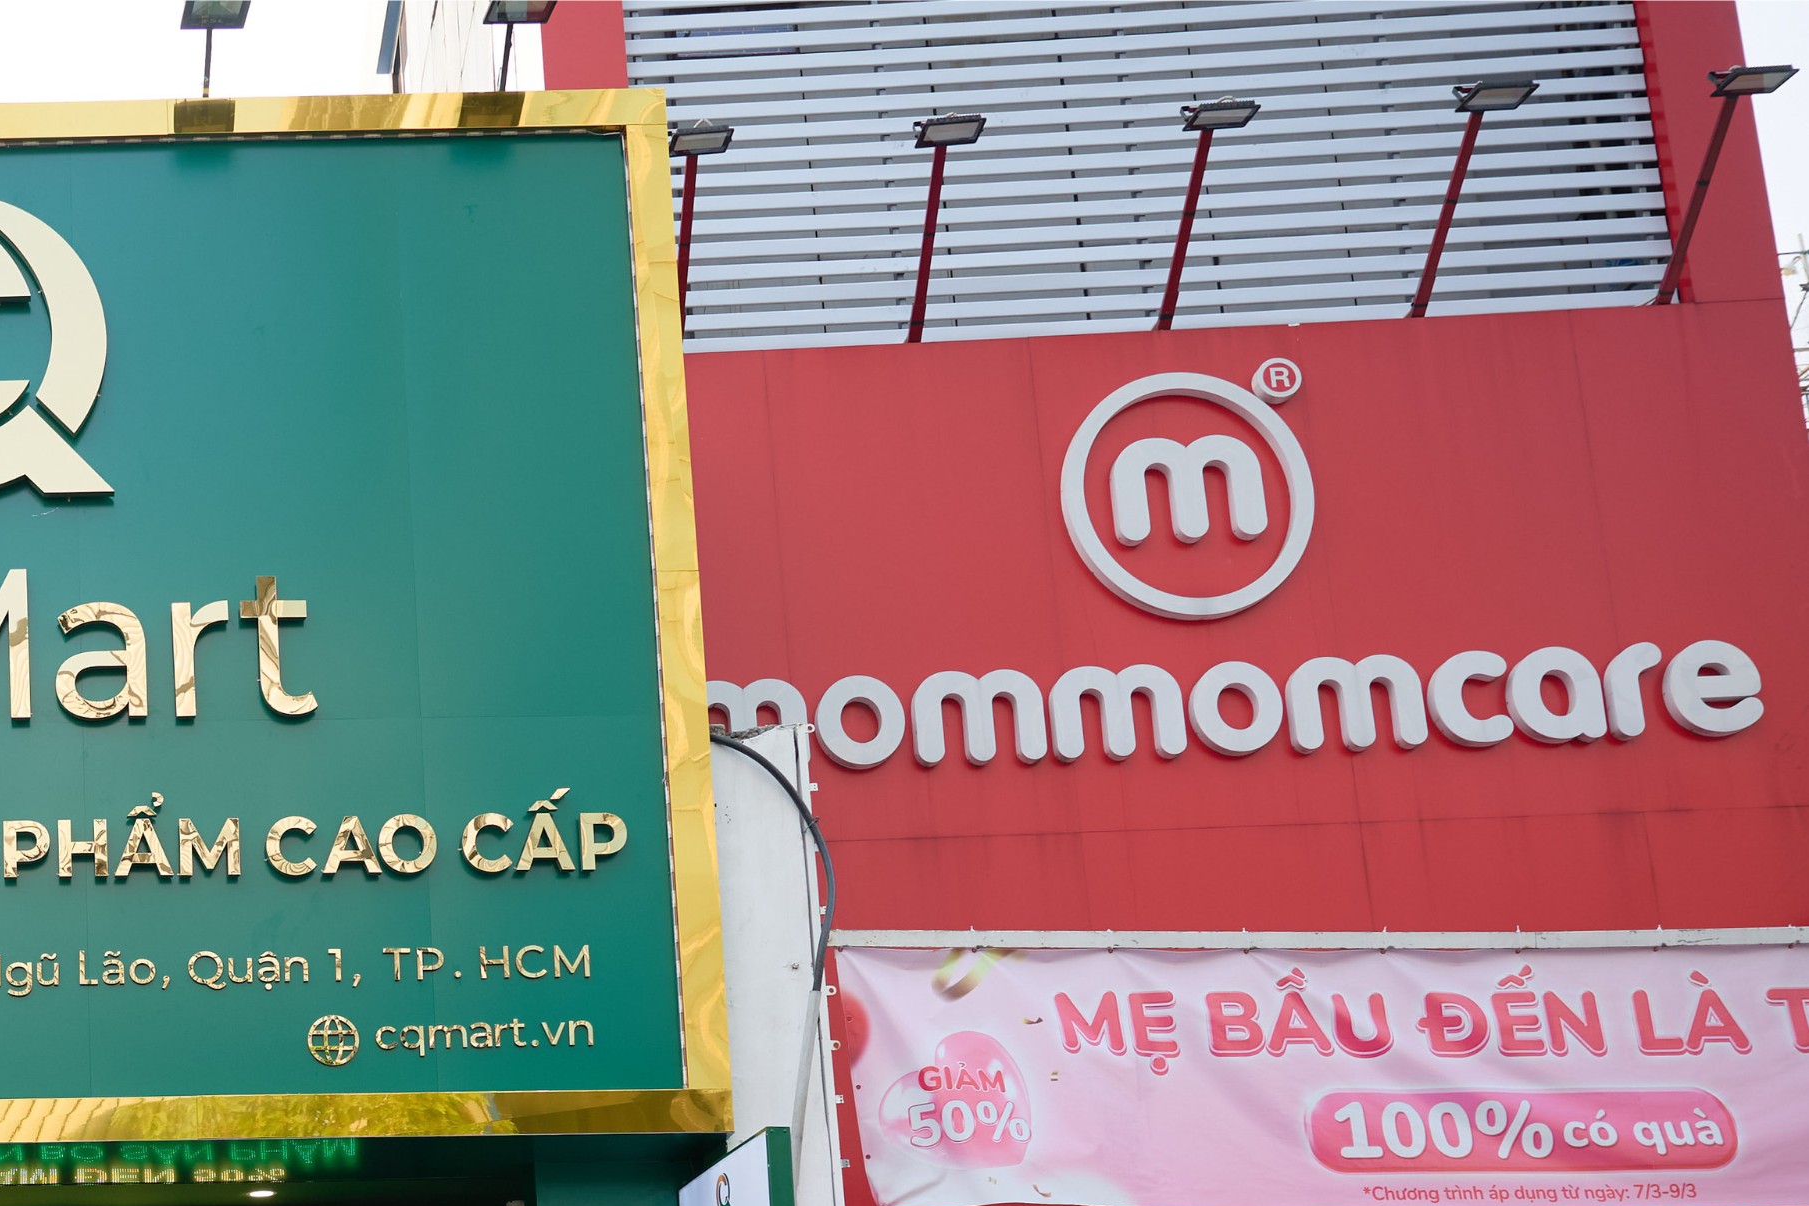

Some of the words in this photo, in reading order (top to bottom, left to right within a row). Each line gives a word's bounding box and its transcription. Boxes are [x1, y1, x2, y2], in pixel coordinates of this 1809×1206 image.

[2, 791, 242, 881] PHẨM
[264, 812, 439, 877] CAO
[459, 787, 629, 875] CẤP
[78, 949, 172, 990] Lão,
[187, 949, 310, 992] Quận
[327, 947, 364, 989] 1,
[480, 944, 593, 980] HCM
[374, 1017, 595, 1058] cqmart.vn
[1054, 989, 1183, 1077] MẸ
[1205, 965, 1395, 1060] BẦU
[1415, 963, 1610, 1059] ĐẾN
[1631, 968, 1754, 1057] LÀ
[917, 1061, 1008, 1094] GIẢM
[908, 1099, 1033, 1149] 50%
[1333, 1099, 1556, 1160] 100%
[1563, 1109, 1619, 1149] có
[1634, 1108, 1726, 1155] quà
[1443, 1183, 1485, 1202] trình
[1488, 1185, 1510, 1204] áp
[1513, 1184, 1556, 1204] dụng
[1560, 1183, 1580, 1201] từ
[1583, 1183, 1631, 1204] ngày:
[1632, 1182, 1698, 1201] 7/3-9/3
